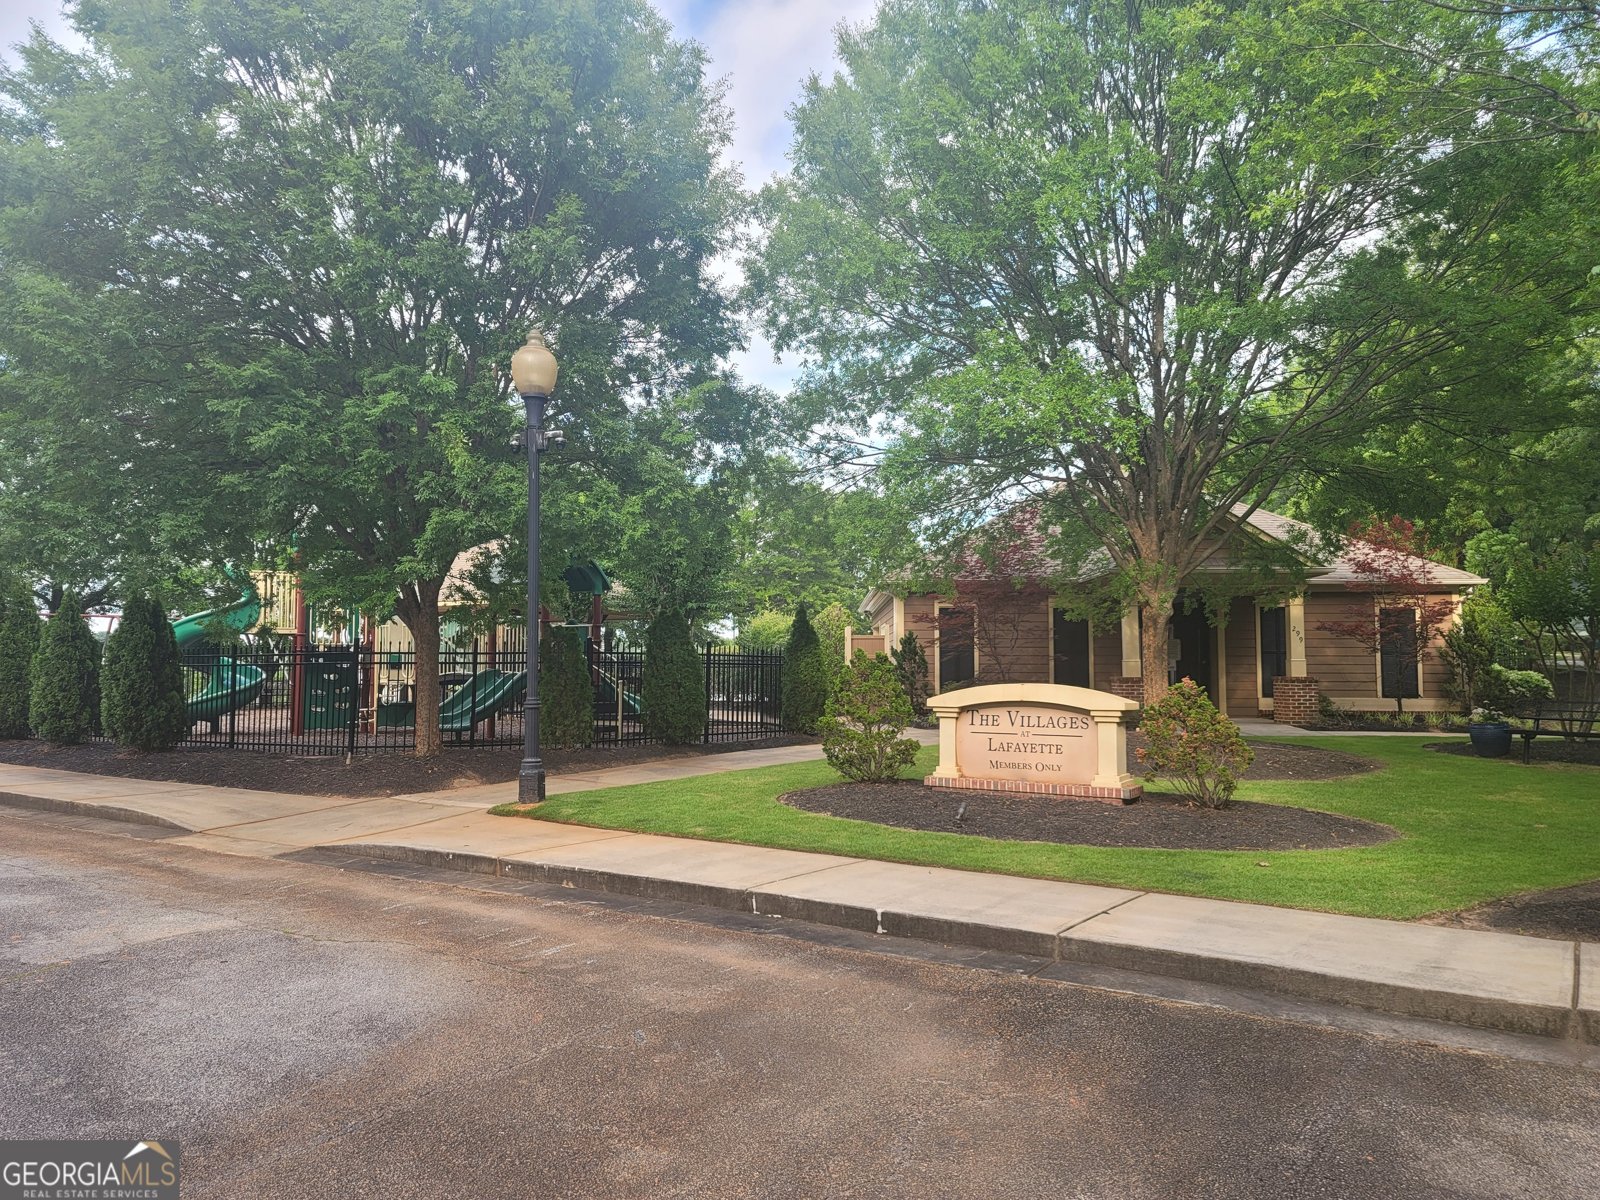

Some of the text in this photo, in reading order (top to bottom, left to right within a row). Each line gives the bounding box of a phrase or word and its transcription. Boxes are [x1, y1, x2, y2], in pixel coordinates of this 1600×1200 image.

[1292, 625, 1304, 644] 299
[966, 709, 1090, 730] THE VILLAGES
[1020, 730, 1031, 738] AT
[987, 737, 1064, 755] LAFAYETTE
[989, 759, 1063, 772] MEMBERS ONLY
